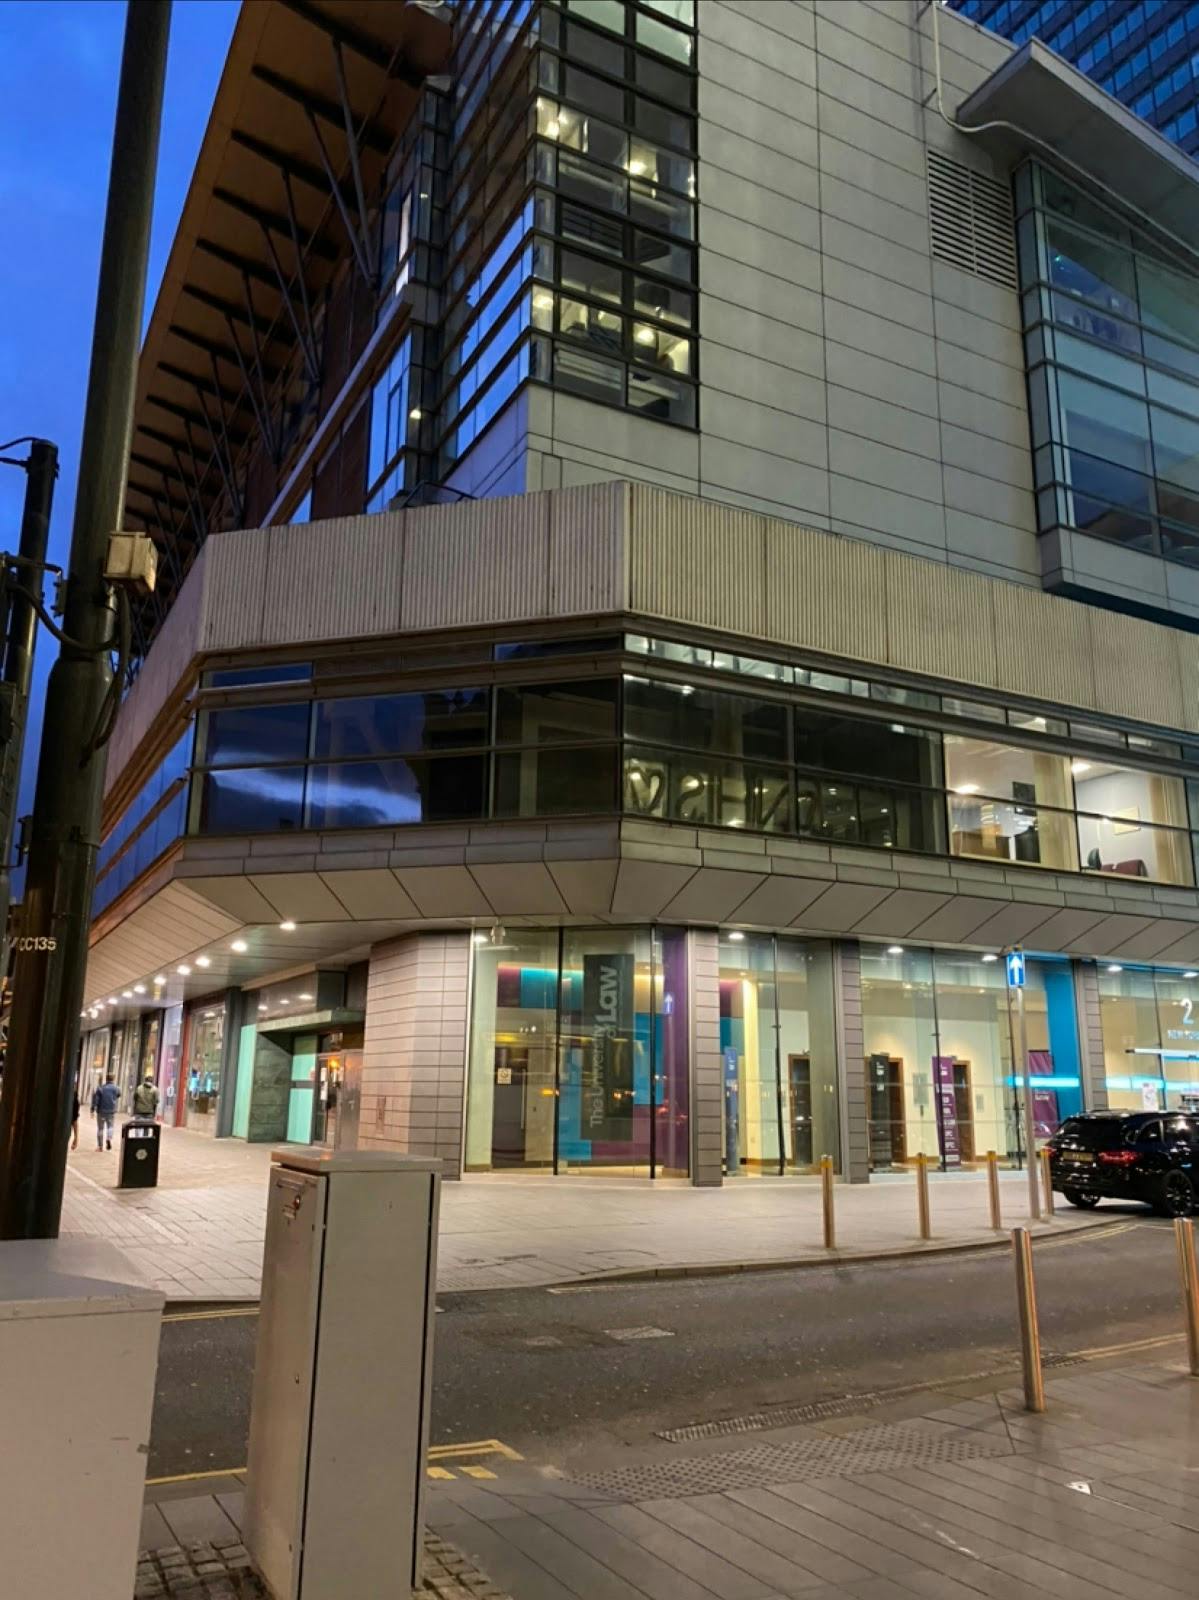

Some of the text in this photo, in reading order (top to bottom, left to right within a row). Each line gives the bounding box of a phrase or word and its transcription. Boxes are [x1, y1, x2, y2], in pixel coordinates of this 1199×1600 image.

[595, 965, 618, 1023] Law
[1180, 997, 1194, 1025] 2
[590, 1097, 604, 1128] The
